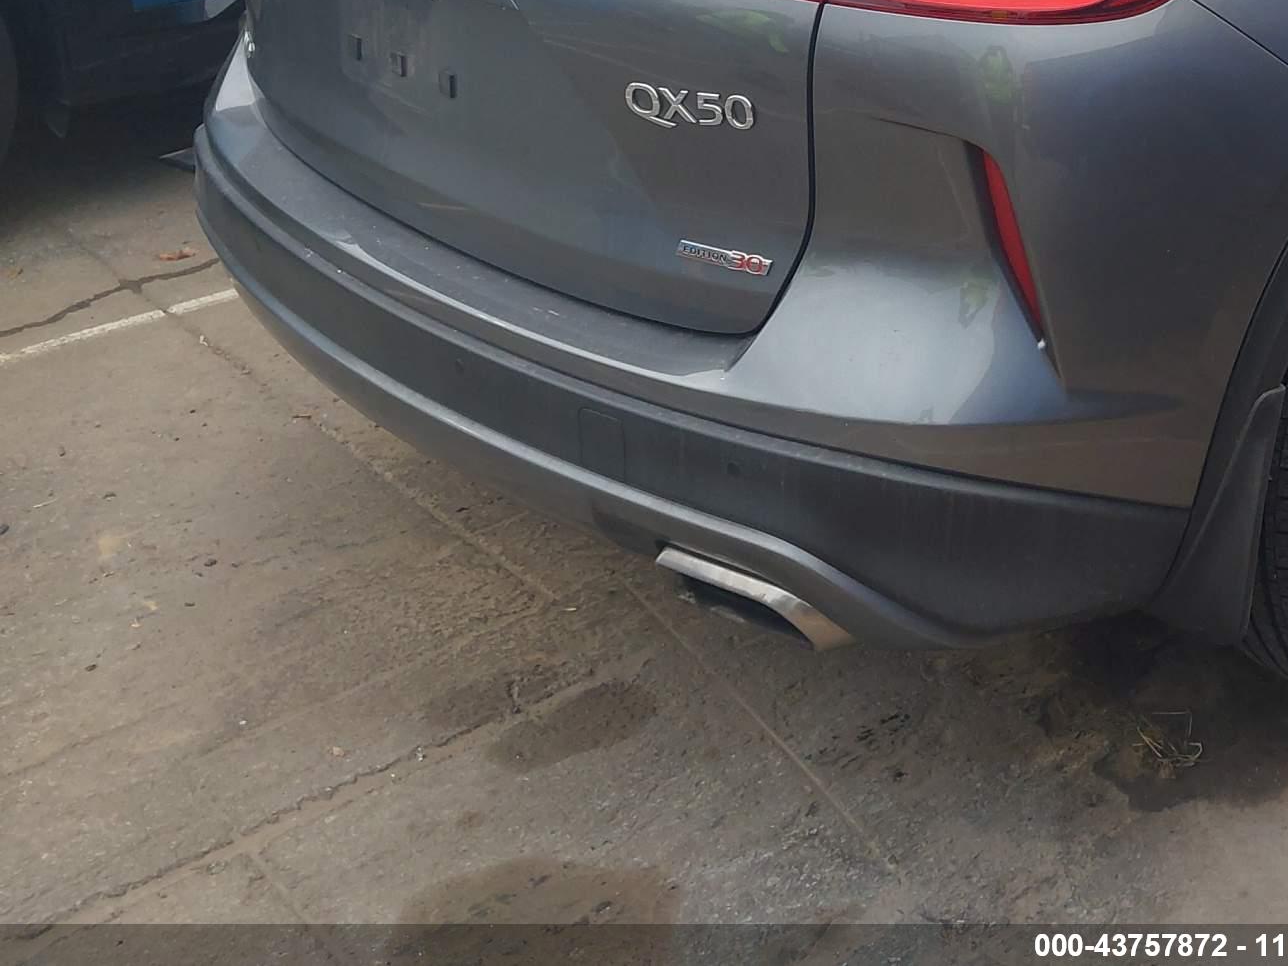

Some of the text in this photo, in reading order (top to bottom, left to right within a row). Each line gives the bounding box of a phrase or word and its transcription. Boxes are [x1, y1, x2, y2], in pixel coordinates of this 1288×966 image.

[625, 82, 754, 130] QX50
[682, 245, 764, 273] EDITION 30
